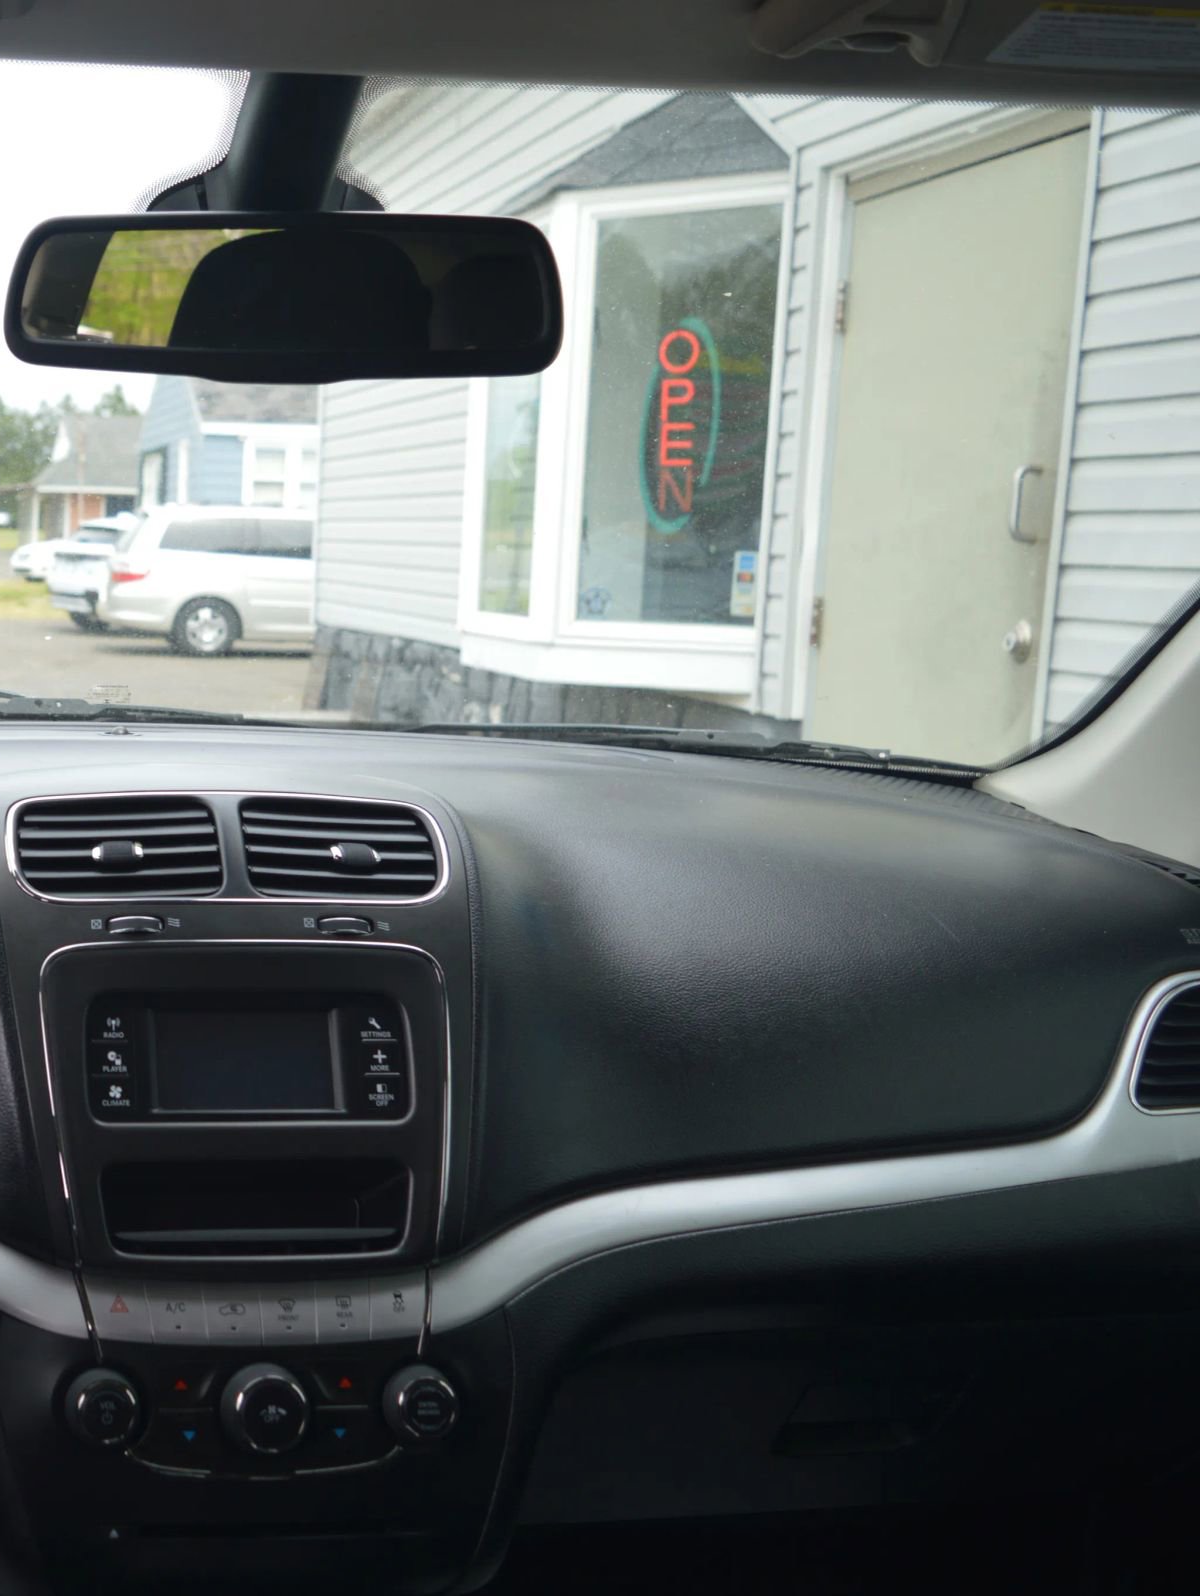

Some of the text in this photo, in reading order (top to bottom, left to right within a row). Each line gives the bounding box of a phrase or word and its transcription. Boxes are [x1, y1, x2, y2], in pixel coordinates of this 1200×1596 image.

[658, 329, 700, 513] OPEN
[103, 1031, 125, 1039] RADIO
[102, 1065, 128, 1073] PLAYER
[368, 1093, 395, 1101] SCREEN
[101, 1099, 131, 1107] CLIMATE
[165, 1302, 186, 1315] A/C
